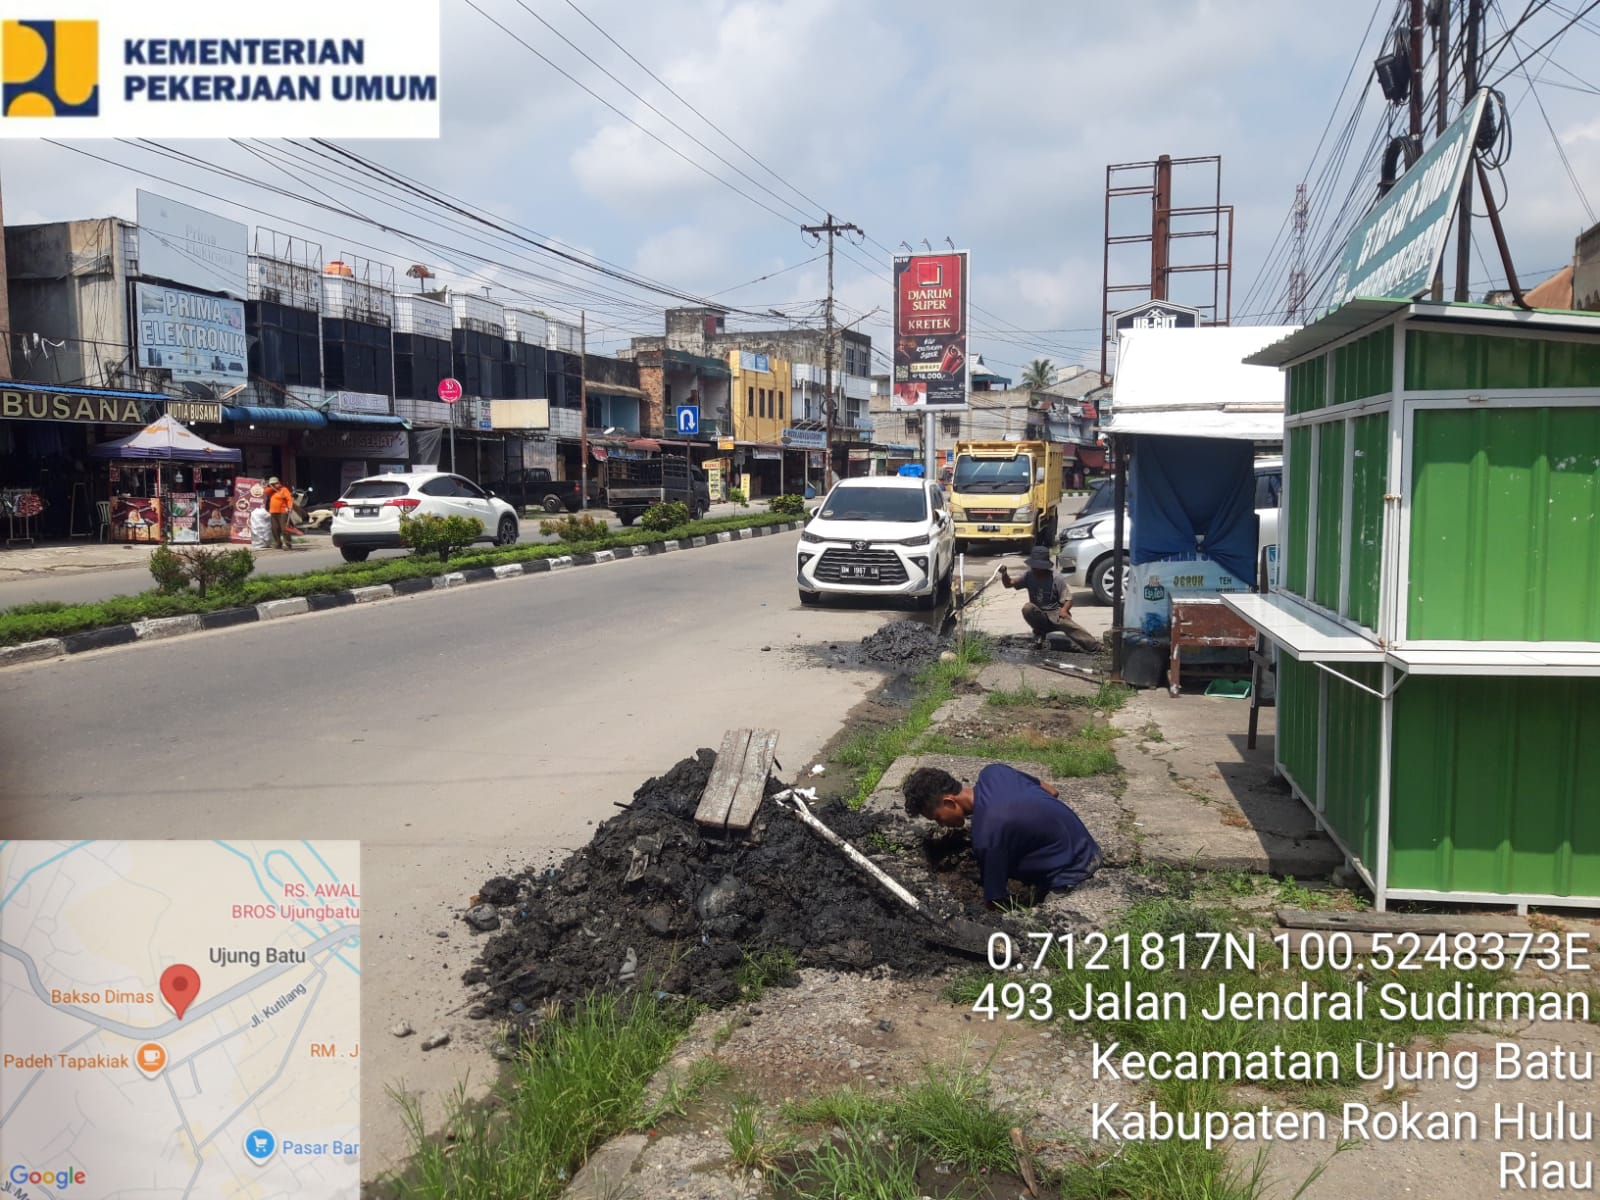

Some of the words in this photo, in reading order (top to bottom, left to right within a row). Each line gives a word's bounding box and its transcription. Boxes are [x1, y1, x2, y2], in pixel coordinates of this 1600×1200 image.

[1410, 132, 1464, 223] JUMBO
[894, 256, 909, 264] NEW
[908, 288, 953, 301] DJARUM
[164, 290, 223, 325] PRIMA
[912, 299, 947, 311] SUPER
[908, 317, 952, 331] KRETEK
[140, 319, 246, 359] ELEKTRONIK
[2, 391, 141, 422] BUSANA
[190, 403, 219, 422] BUSANA
[1219, 576, 1232, 585] TEH
